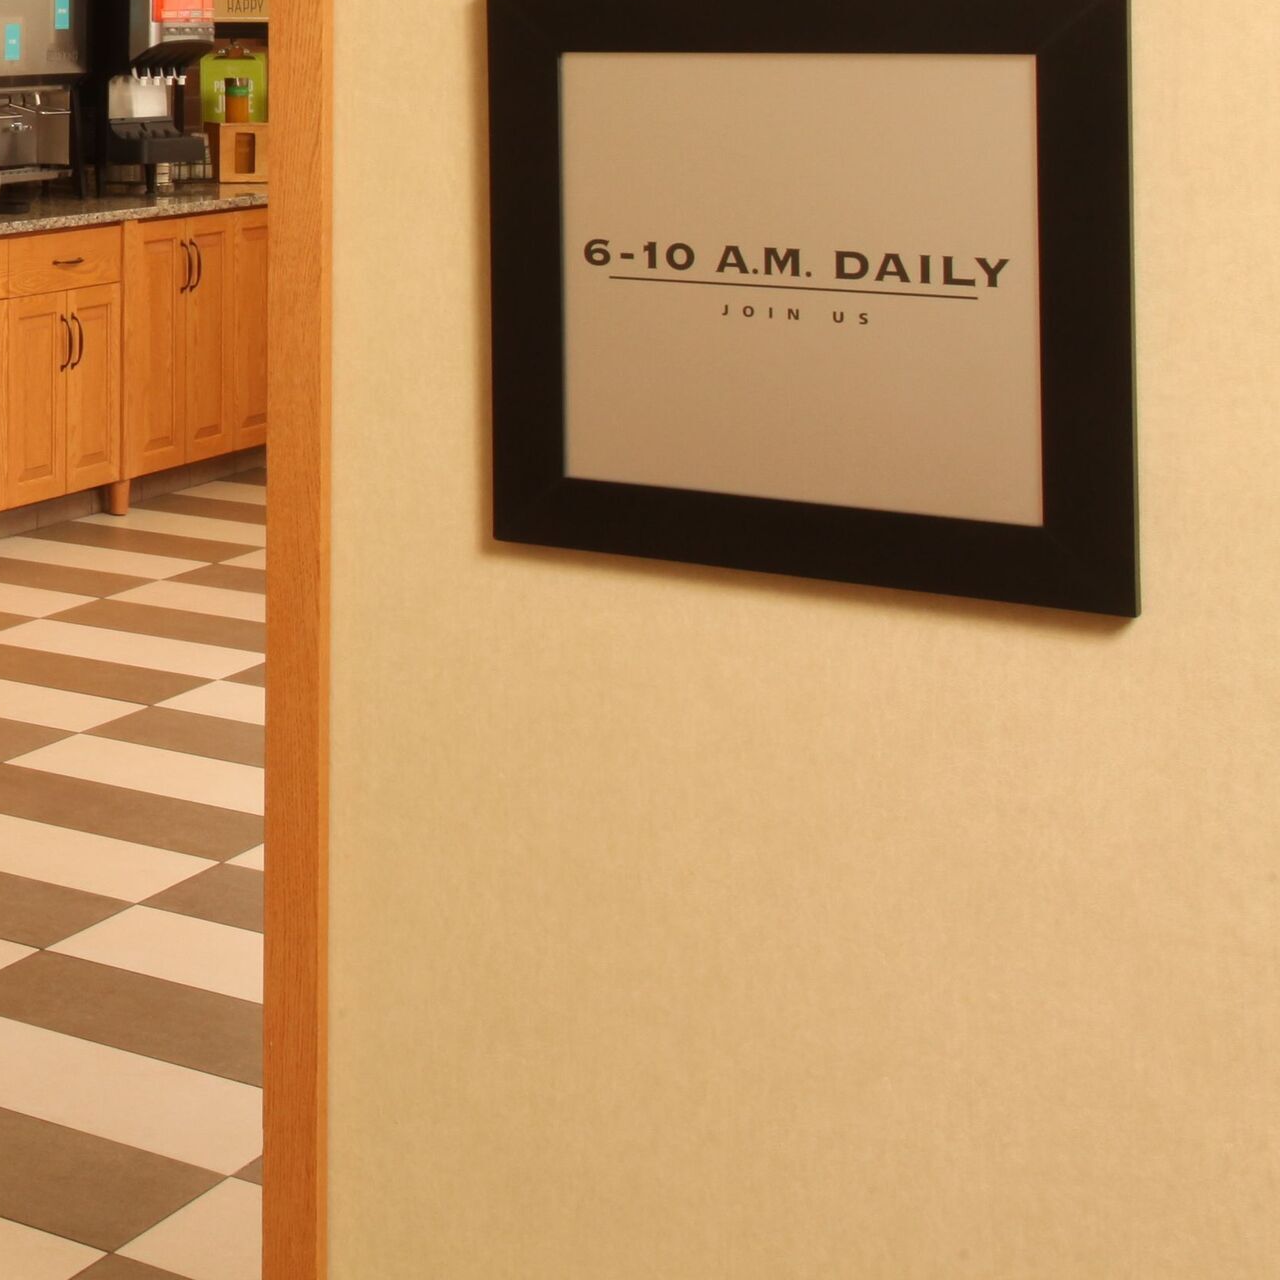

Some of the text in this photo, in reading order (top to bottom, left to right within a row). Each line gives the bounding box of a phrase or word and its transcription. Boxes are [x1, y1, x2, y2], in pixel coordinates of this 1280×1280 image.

[583, 238, 1010, 288] 6-10 A.M. DAILY
[721, 304, 869, 325] JOIN US
